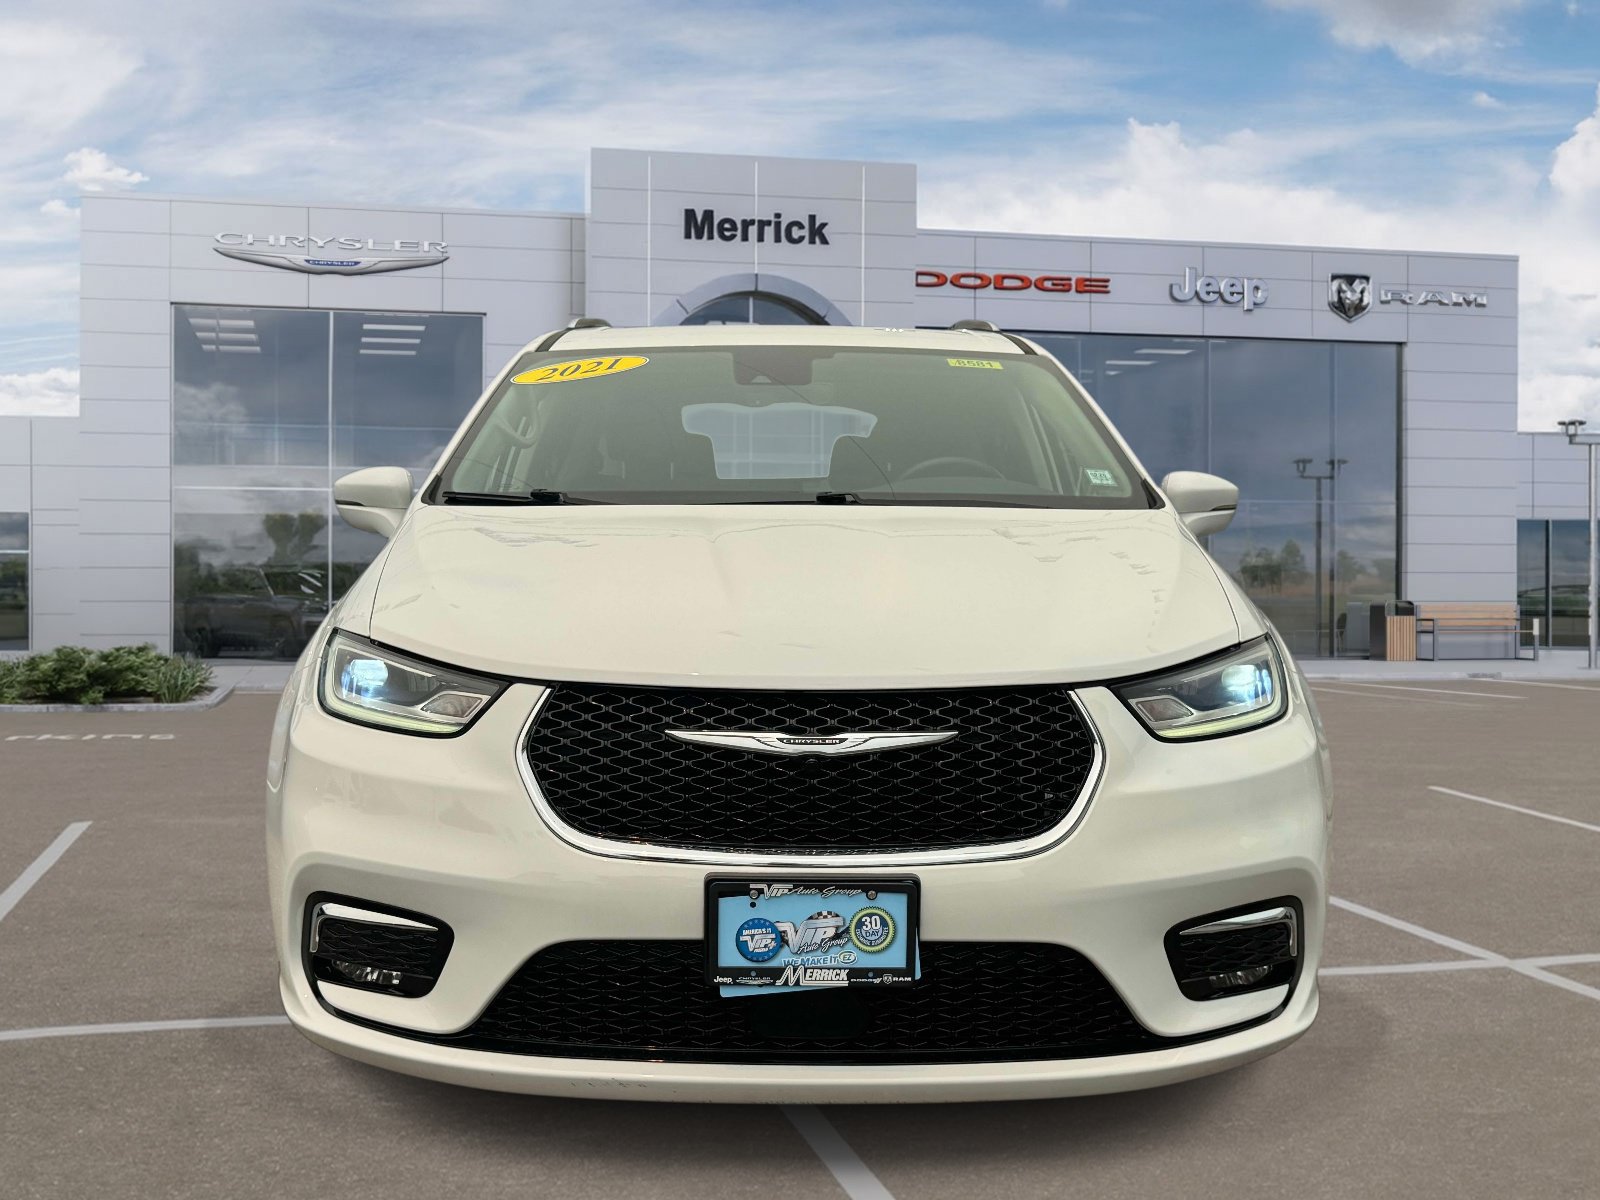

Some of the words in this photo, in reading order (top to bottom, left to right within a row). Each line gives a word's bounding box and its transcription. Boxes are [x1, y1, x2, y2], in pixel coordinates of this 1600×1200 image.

[684, 208, 830, 245] Merrick
[213, 232, 449, 254] CHRYSLER
[915, 271, 1111, 294] DODGE
[1169, 266, 1269, 312] Jeep
[1379, 288, 1488, 308] RAM
[536, 357, 624, 382] 2021
[749, 883, 794, 900] VIP
[787, 886, 819, 895] Auto
[821, 885, 863, 898] Group
[861, 915, 881, 931] 30
[740, 933, 776, 952] VIP
[774, 917, 844, 954] VIP
[865, 930, 881, 938] DAY
[797, 940, 820, 954] Auto
[821, 937, 849, 953] Group
[801, 957, 828, 966] MAKE
[829, 955, 840, 965] IT
[842, 953, 853, 961] EZ
[713, 975, 732, 984] Jeep
[775, 965, 850, 987] MERRICK
